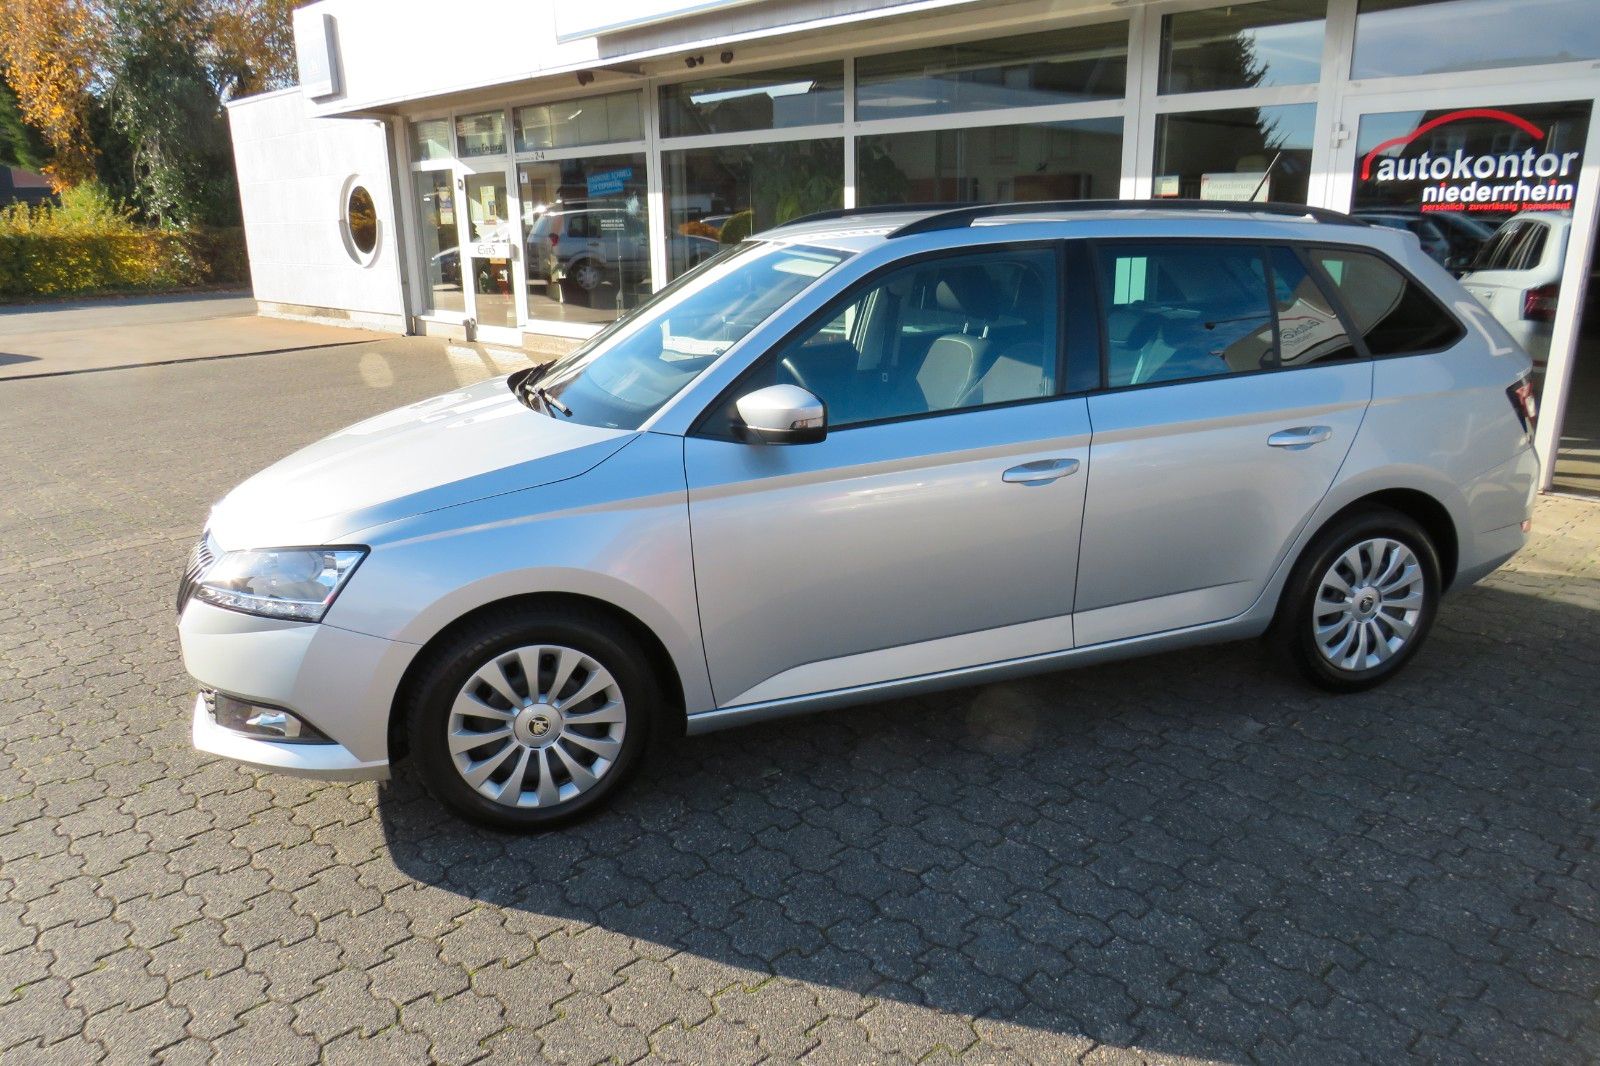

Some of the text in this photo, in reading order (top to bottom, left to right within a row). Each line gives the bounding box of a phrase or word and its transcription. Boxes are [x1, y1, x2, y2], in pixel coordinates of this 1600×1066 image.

[1377, 146, 1579, 181] autokontor
[1422, 179, 1574, 203] niederrhein
[1421, 201, 1571, 212] persönlich zuverlässig kompetent
